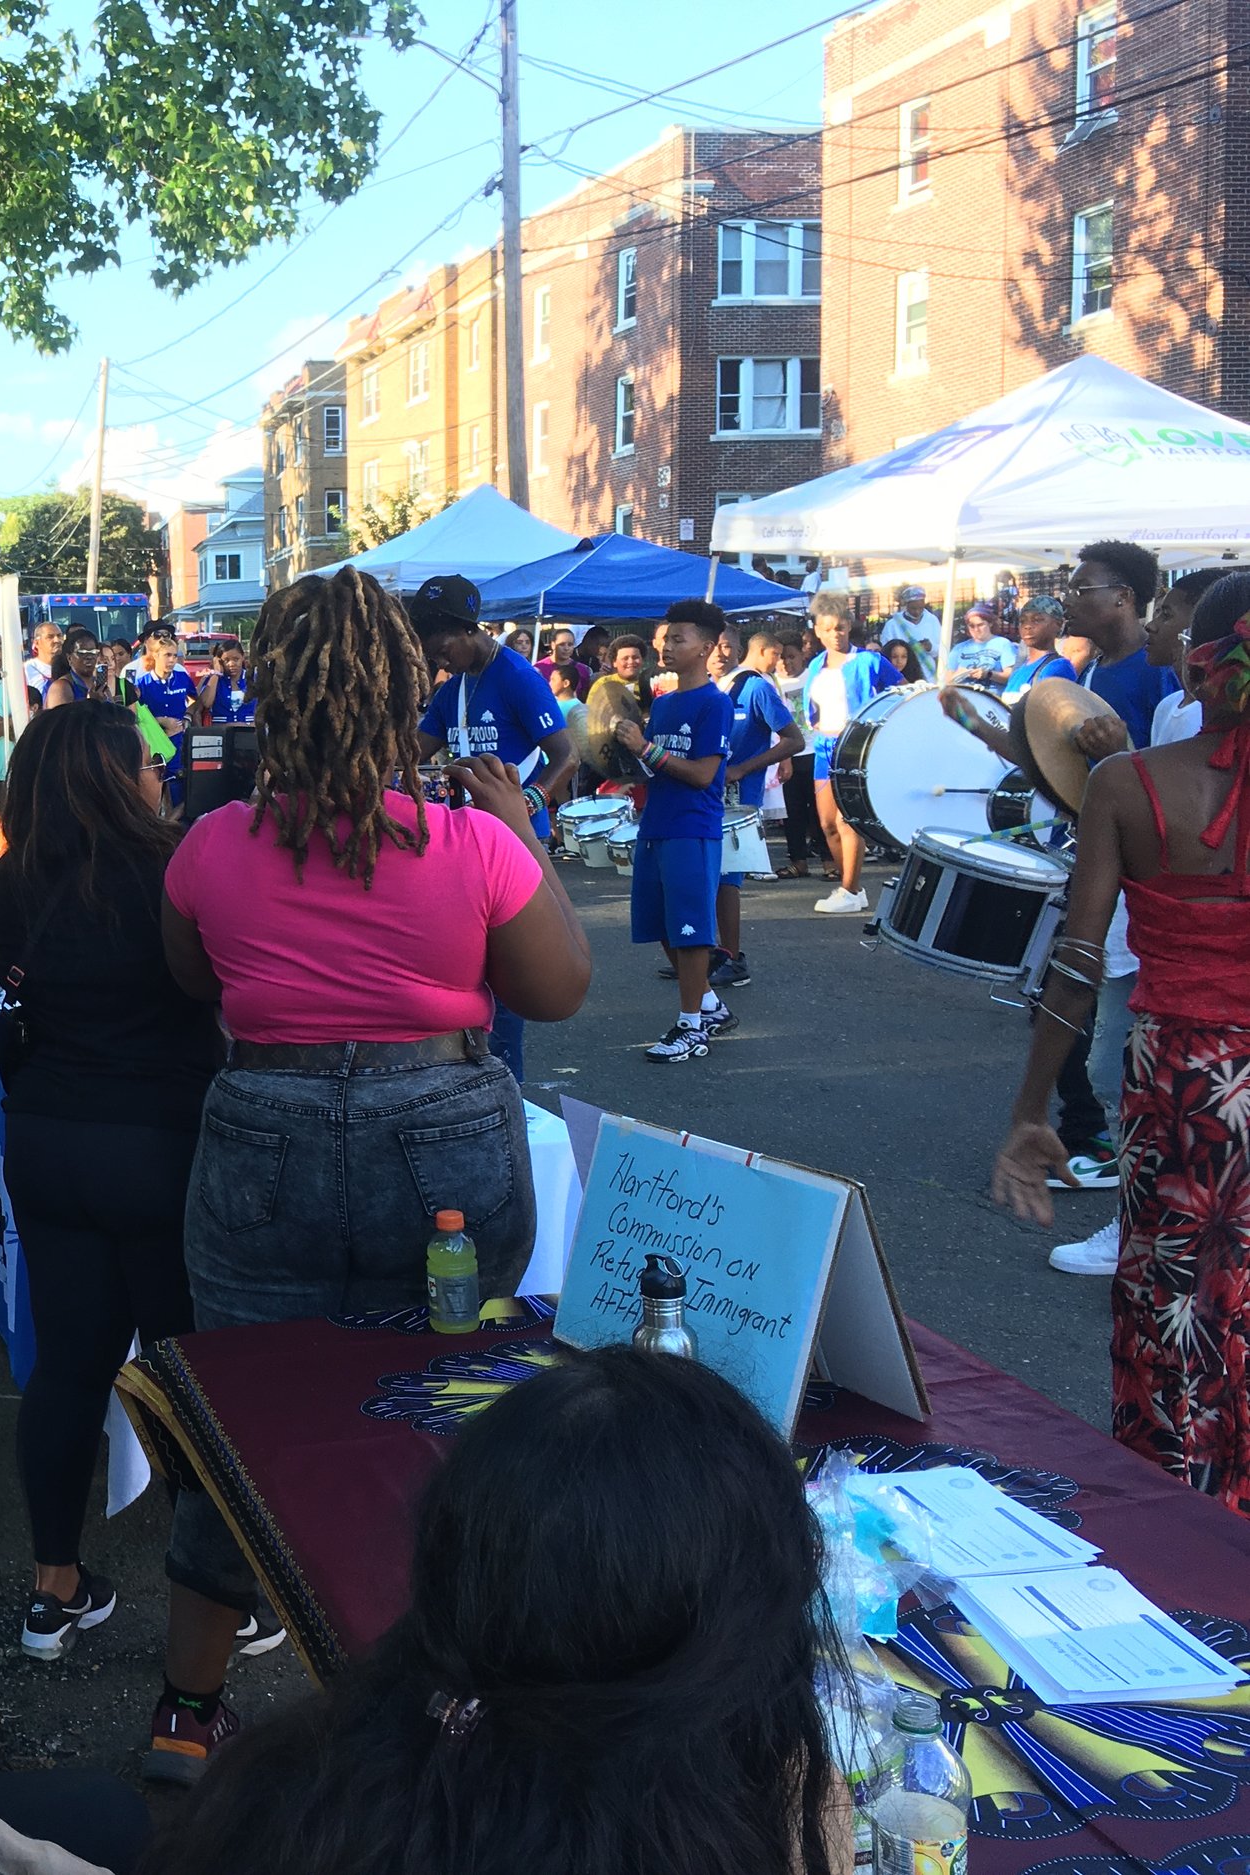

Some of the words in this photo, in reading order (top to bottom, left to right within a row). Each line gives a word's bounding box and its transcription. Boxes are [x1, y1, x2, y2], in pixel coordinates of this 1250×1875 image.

[1127, 427, 1250, 448] LOVE
[1128, 528, 1239, 541] #lovehartford
[539, 711, 554, 729] 13
[470, 725, 499, 743] PROUD
[609, 1152, 725, 1226] Hartford's
[608, 1202, 722, 1268] Commission
[590, 1239, 644, 1297] Refug
[684, 1276, 793, 1339] Immigrant
